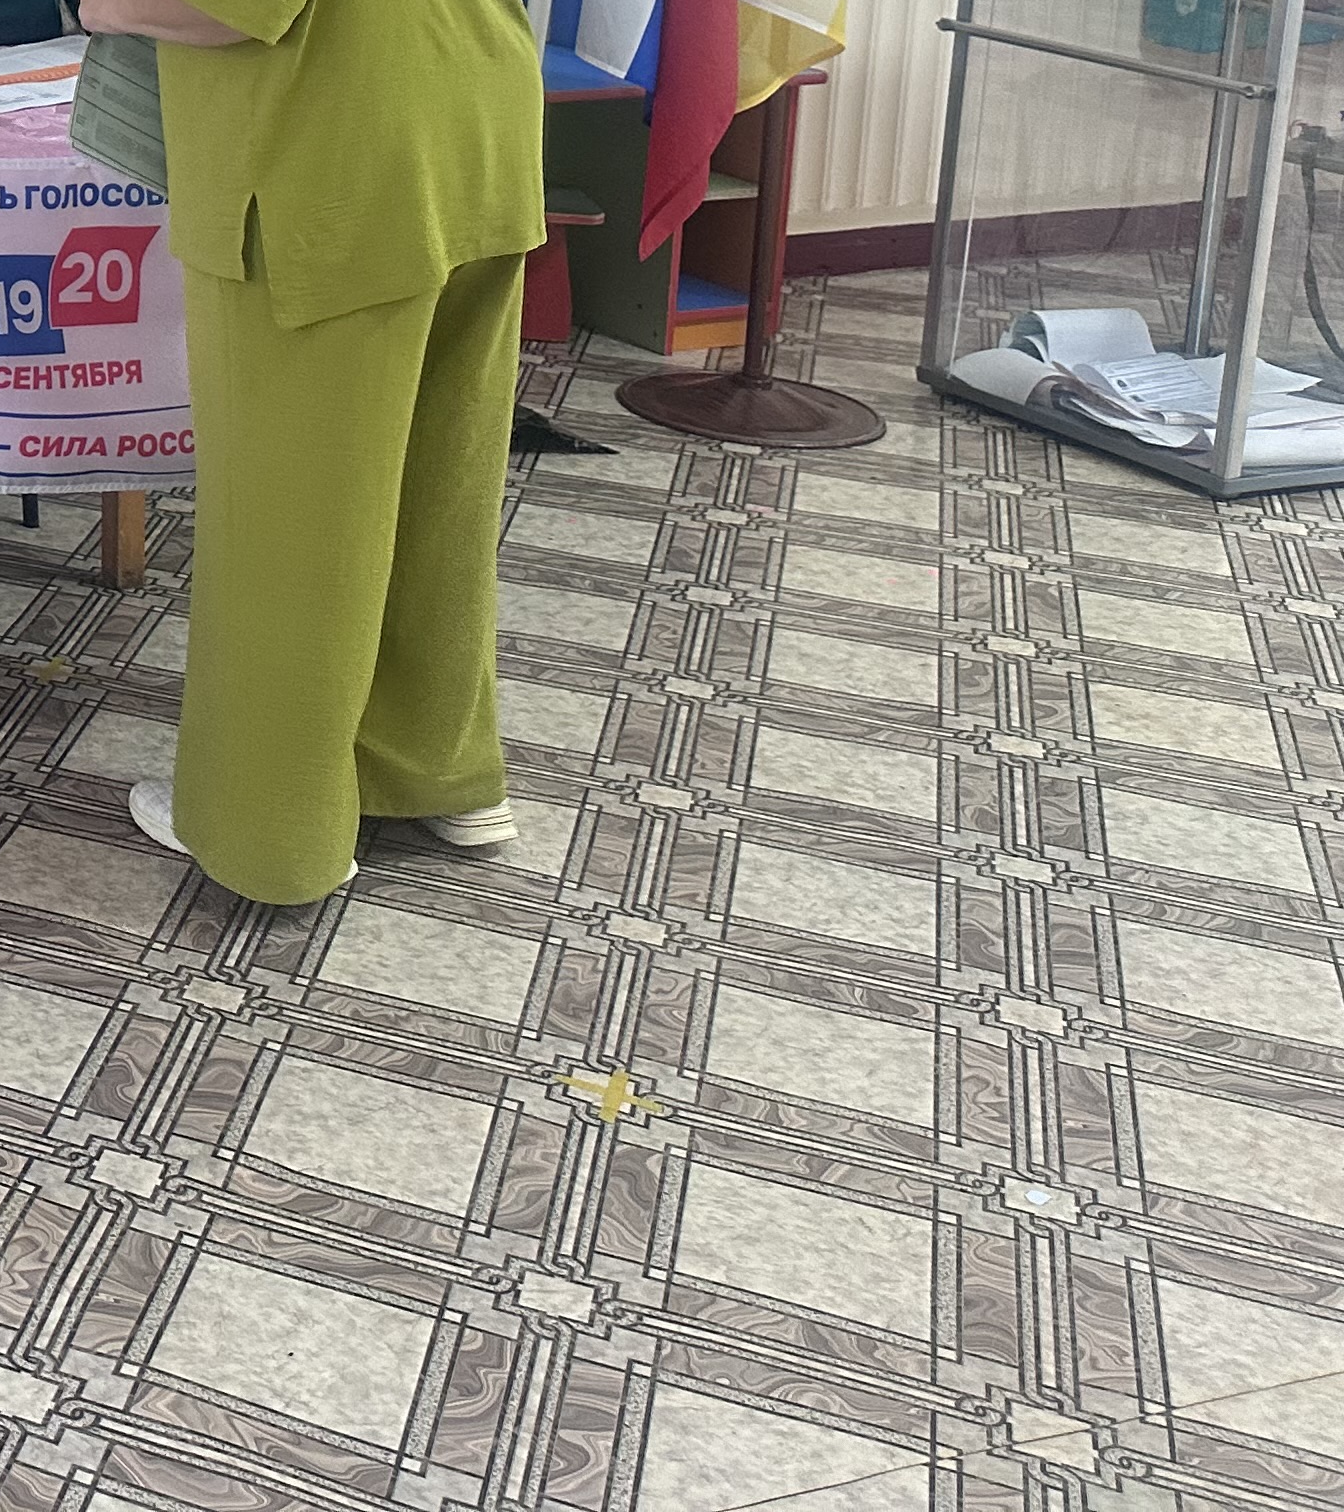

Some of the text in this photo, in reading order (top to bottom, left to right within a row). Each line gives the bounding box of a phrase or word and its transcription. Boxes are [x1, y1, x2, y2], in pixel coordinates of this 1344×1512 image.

[24, 183, 169, 209] ГОЛОСОВ
[58, 249, 133, 304] 20
[18, 436, 107, 458] СИЛА
